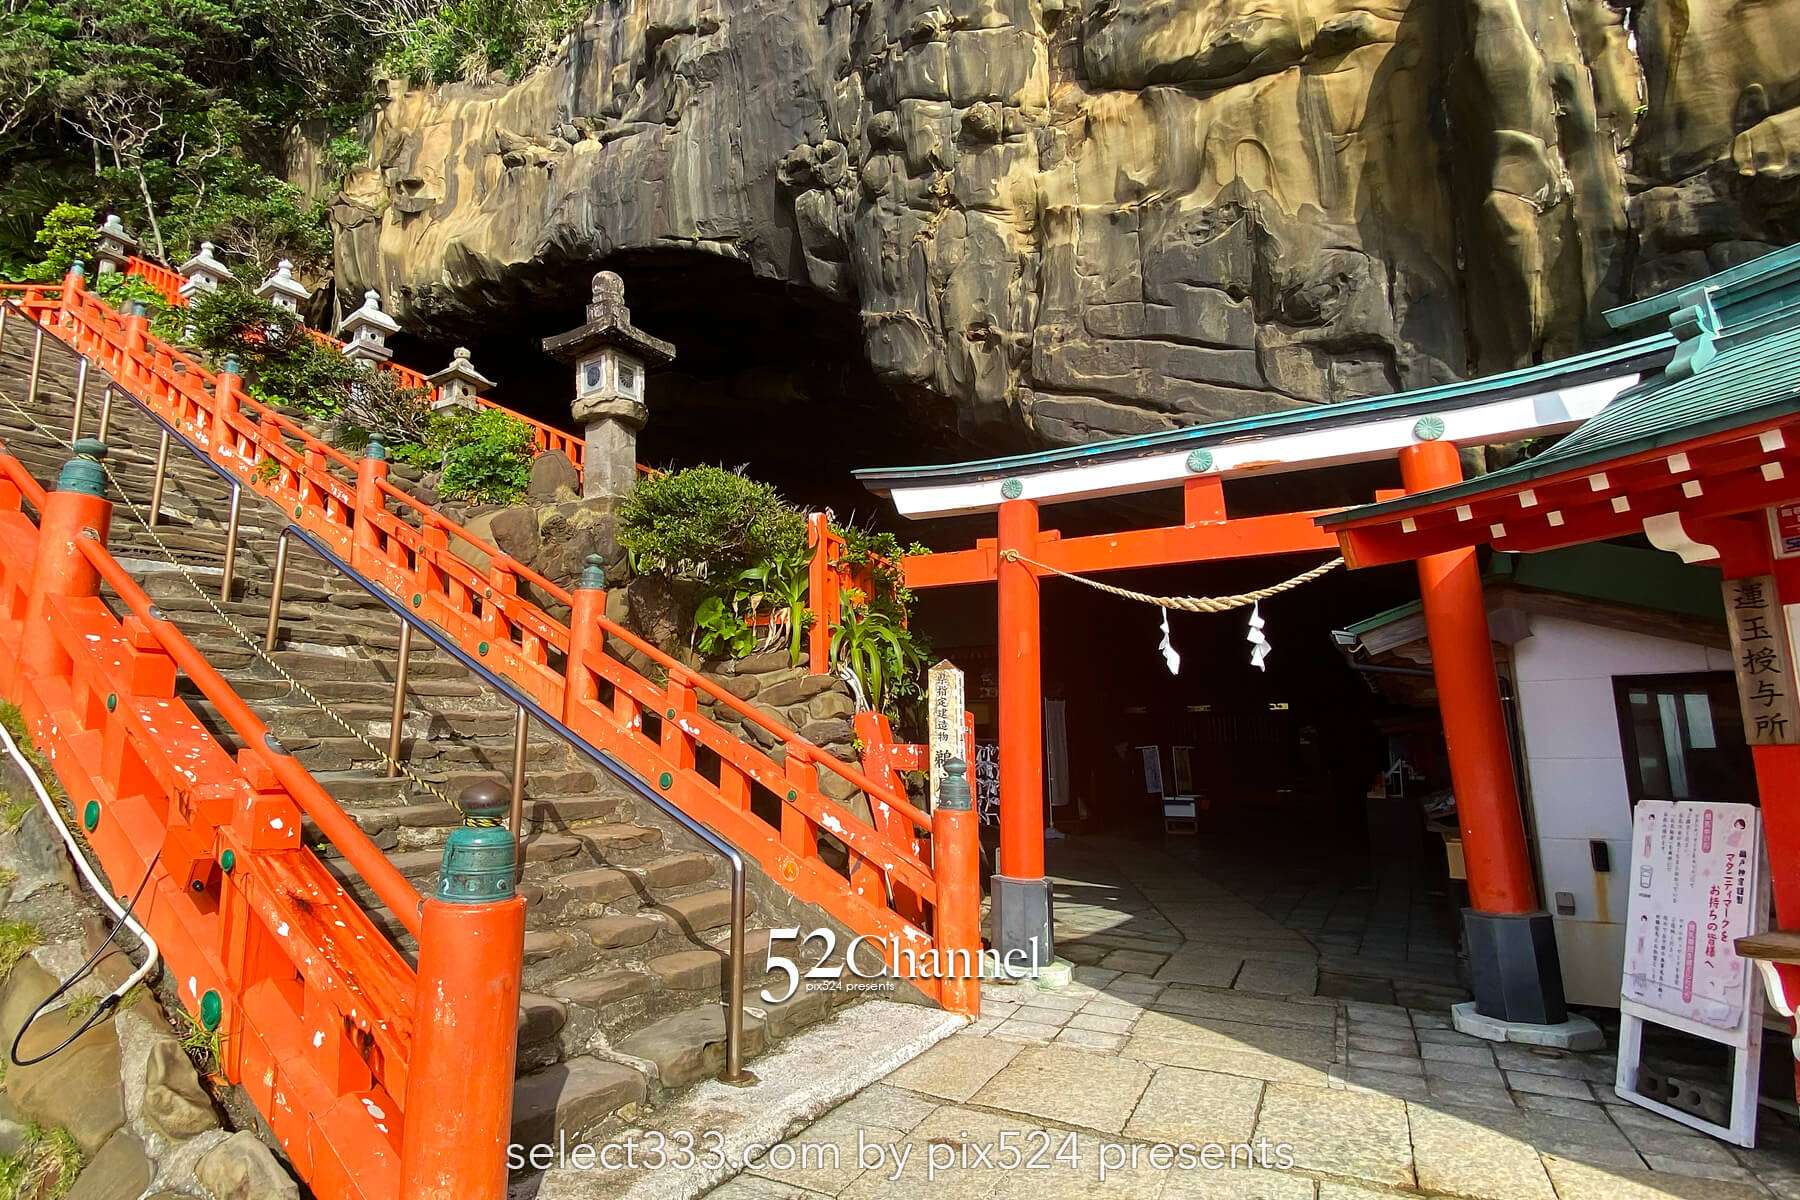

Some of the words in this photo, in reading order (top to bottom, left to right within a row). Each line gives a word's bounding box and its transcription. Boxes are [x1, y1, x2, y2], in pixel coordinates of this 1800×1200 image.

[1734, 582, 1789, 739] 運玉授与所
[936, 671, 950, 743] 県指定建造物
[1704, 883, 1720, 969] お持ちの皆様へ
[1720, 853, 1735, 943] マタニティマークを
